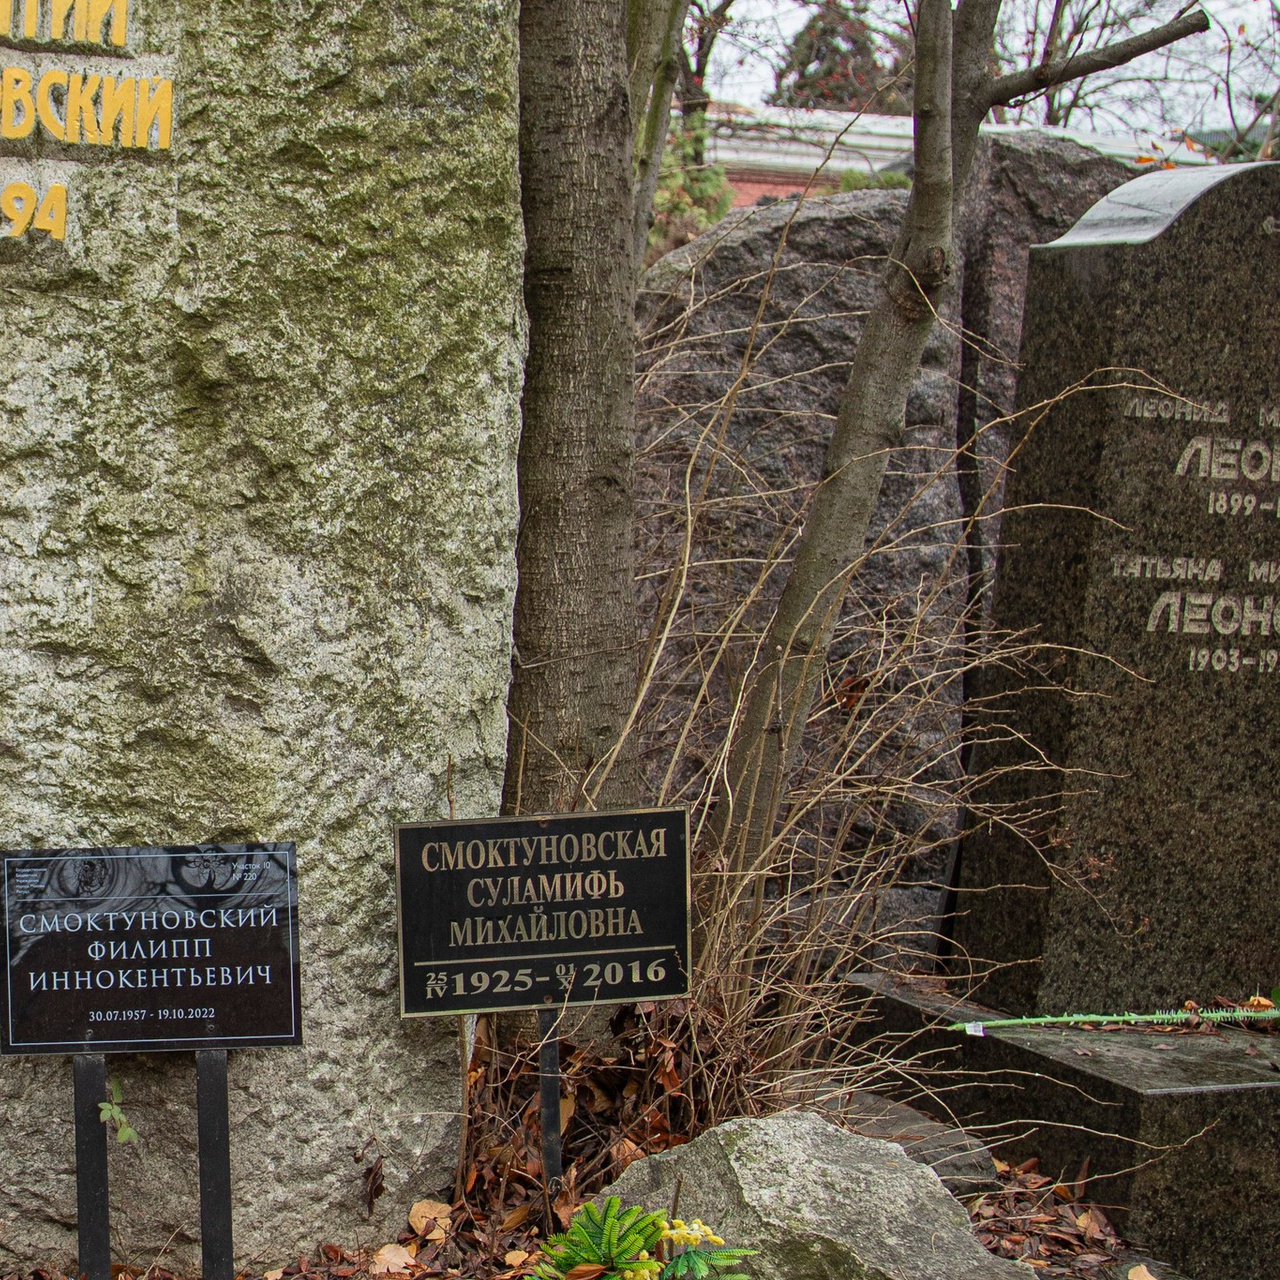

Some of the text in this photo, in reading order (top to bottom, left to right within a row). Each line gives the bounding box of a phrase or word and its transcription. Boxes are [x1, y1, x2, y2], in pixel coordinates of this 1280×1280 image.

[1124, 398, 1230, 424] ЛЕОНИД
[1111, 554, 1223, 581] ТАТЬЯНА
[1146, 592, 1280, 636] ЛЕОН
[421, 828, 668, 872] СМОКТУНОВСКАЯ
[467, 870, 625, 908] СУЛАМИФЬ
[19, 905, 278, 933] СМОКТУНОВСКИЙ
[449, 906, 644, 947] МИХАЙЛОВНА
[88, 938, 212, 961] ФИЛИПП
[29, 965, 272, 992] ИННОКЕНТЬЕВИЧ
[583, 959, 666, 988] 2016
[89, 1009, 147, 1022] 30.07.1957
[158, 1007, 215, 1020] 19.10.2022
